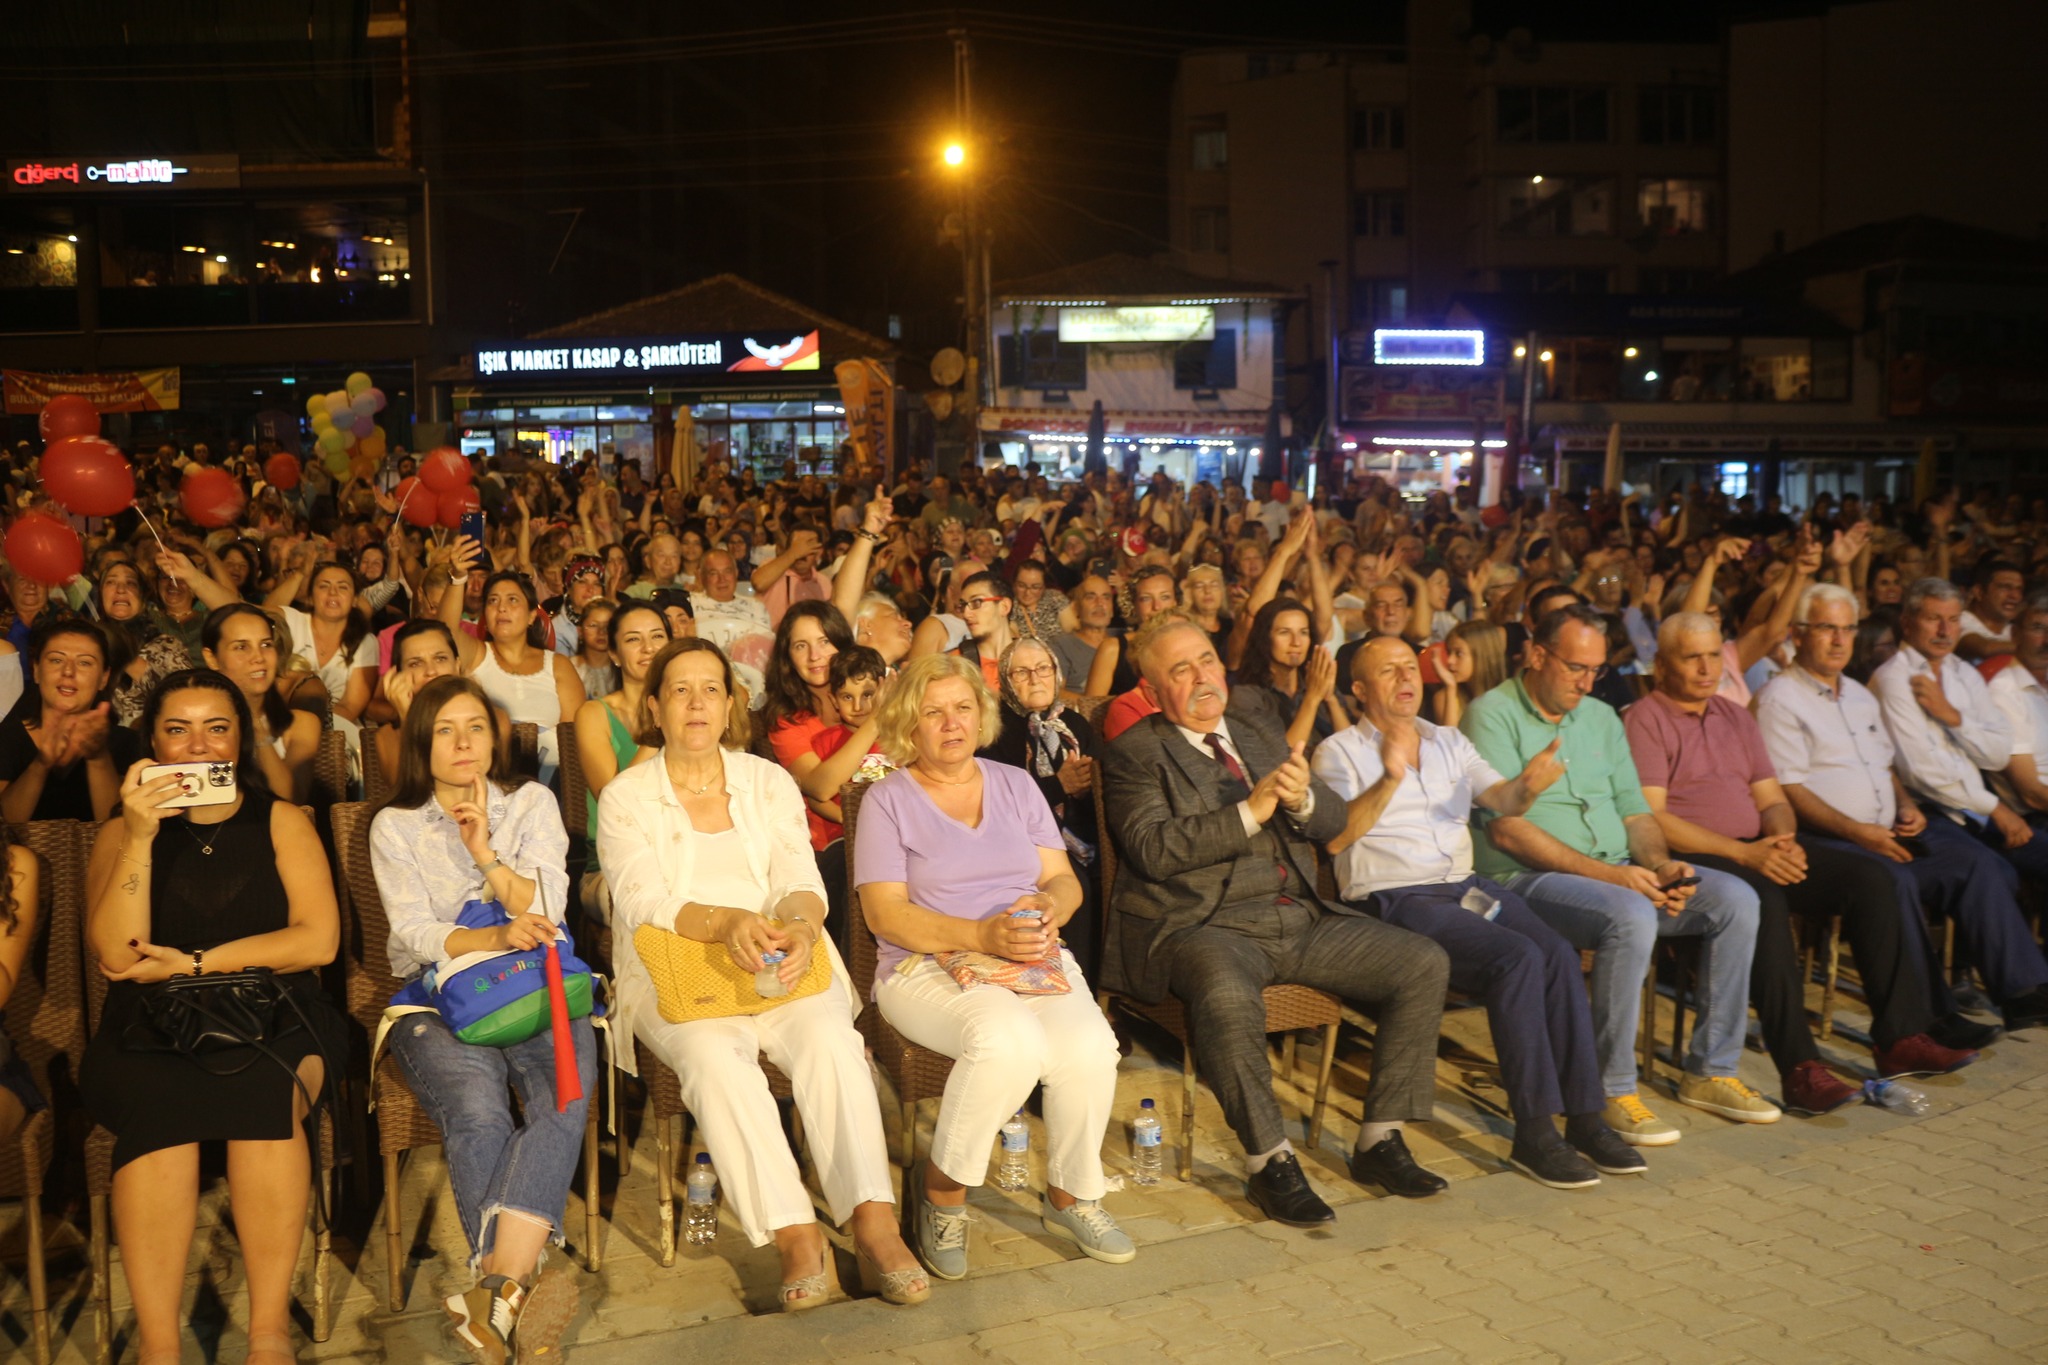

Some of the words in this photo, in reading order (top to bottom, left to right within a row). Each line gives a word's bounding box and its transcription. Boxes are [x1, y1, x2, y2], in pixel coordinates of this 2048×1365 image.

[108, 160, 171, 182] mahir
[479, 350, 508, 375] IŞIK
[510, 349, 569, 371] MARKET
[572, 347, 621, 369] KASAP
[623, 348, 639, 367] &
[641, 340, 722, 370] ŞARKÜTERİ
